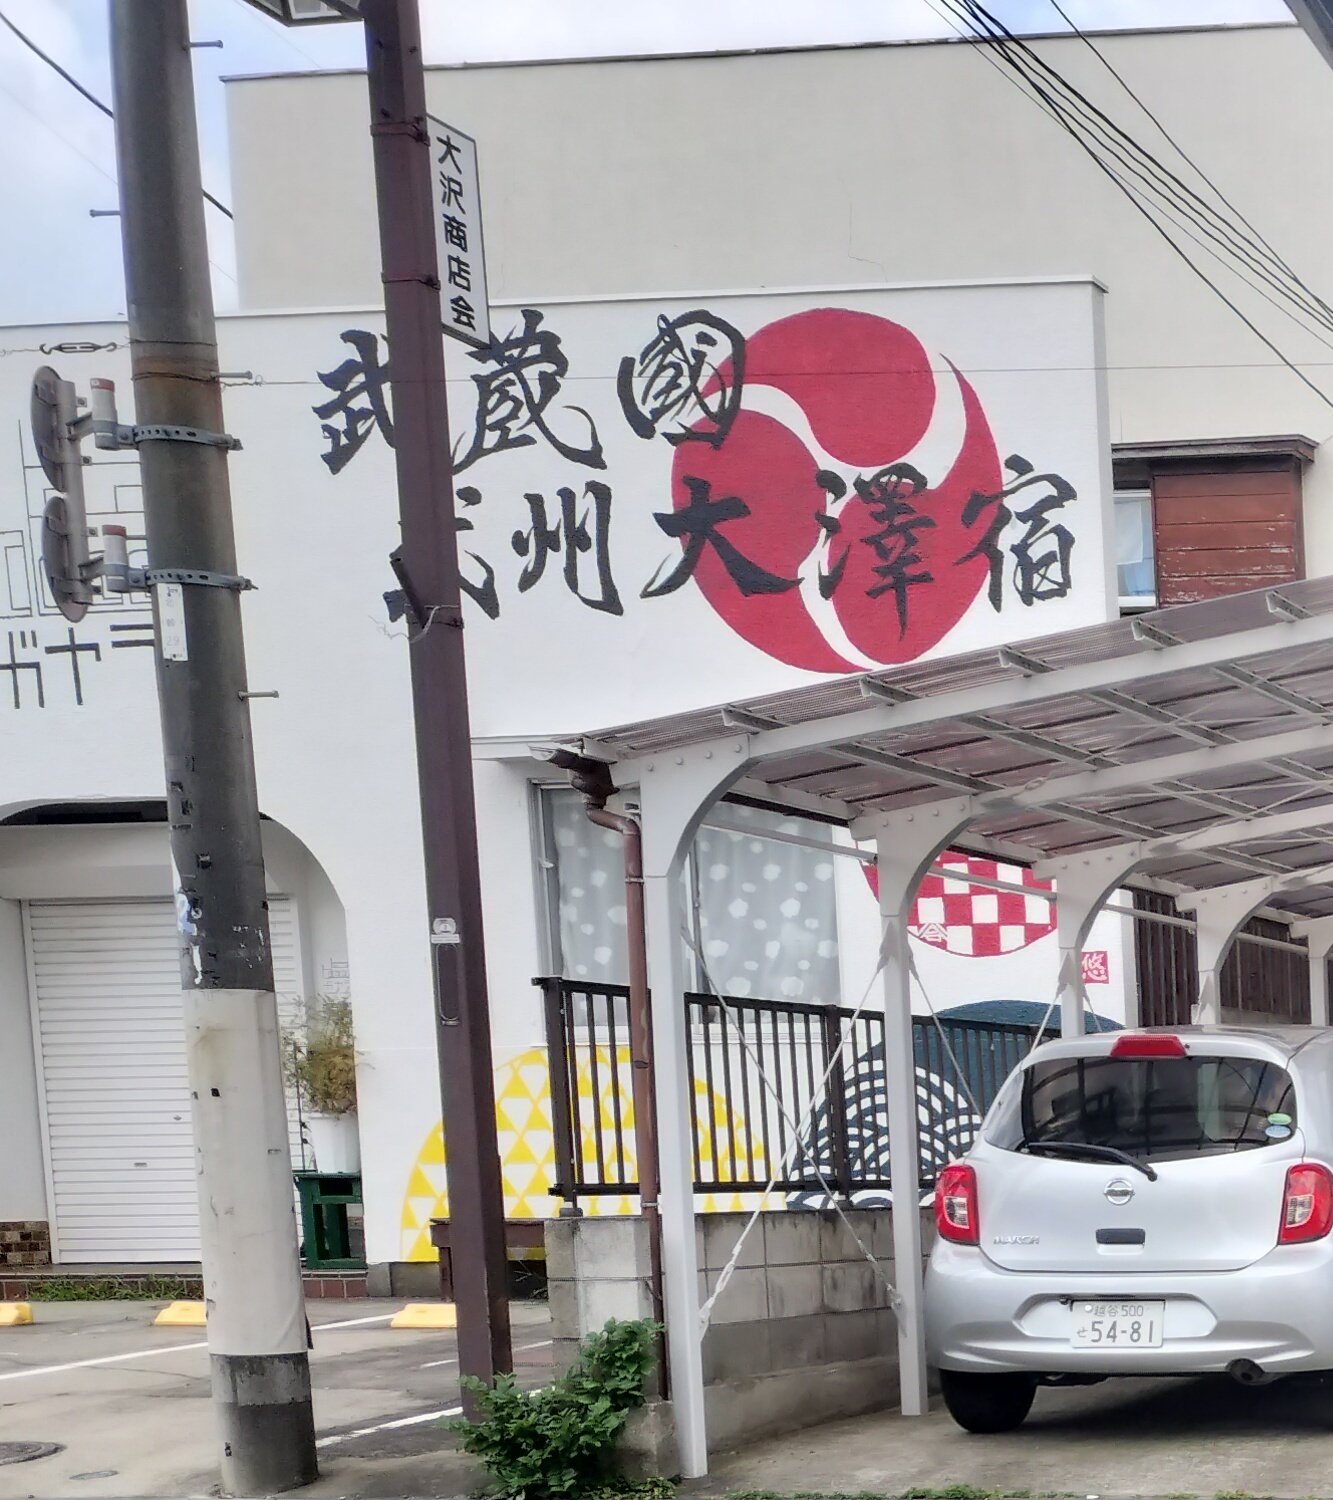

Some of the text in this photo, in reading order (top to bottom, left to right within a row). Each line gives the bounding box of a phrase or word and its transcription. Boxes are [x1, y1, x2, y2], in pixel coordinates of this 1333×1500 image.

[437, 134, 477, 332] 大沢商店会
[1121, 1305, 1144, 1317] 500
[1091, 1320, 1154, 1344] 54-81
